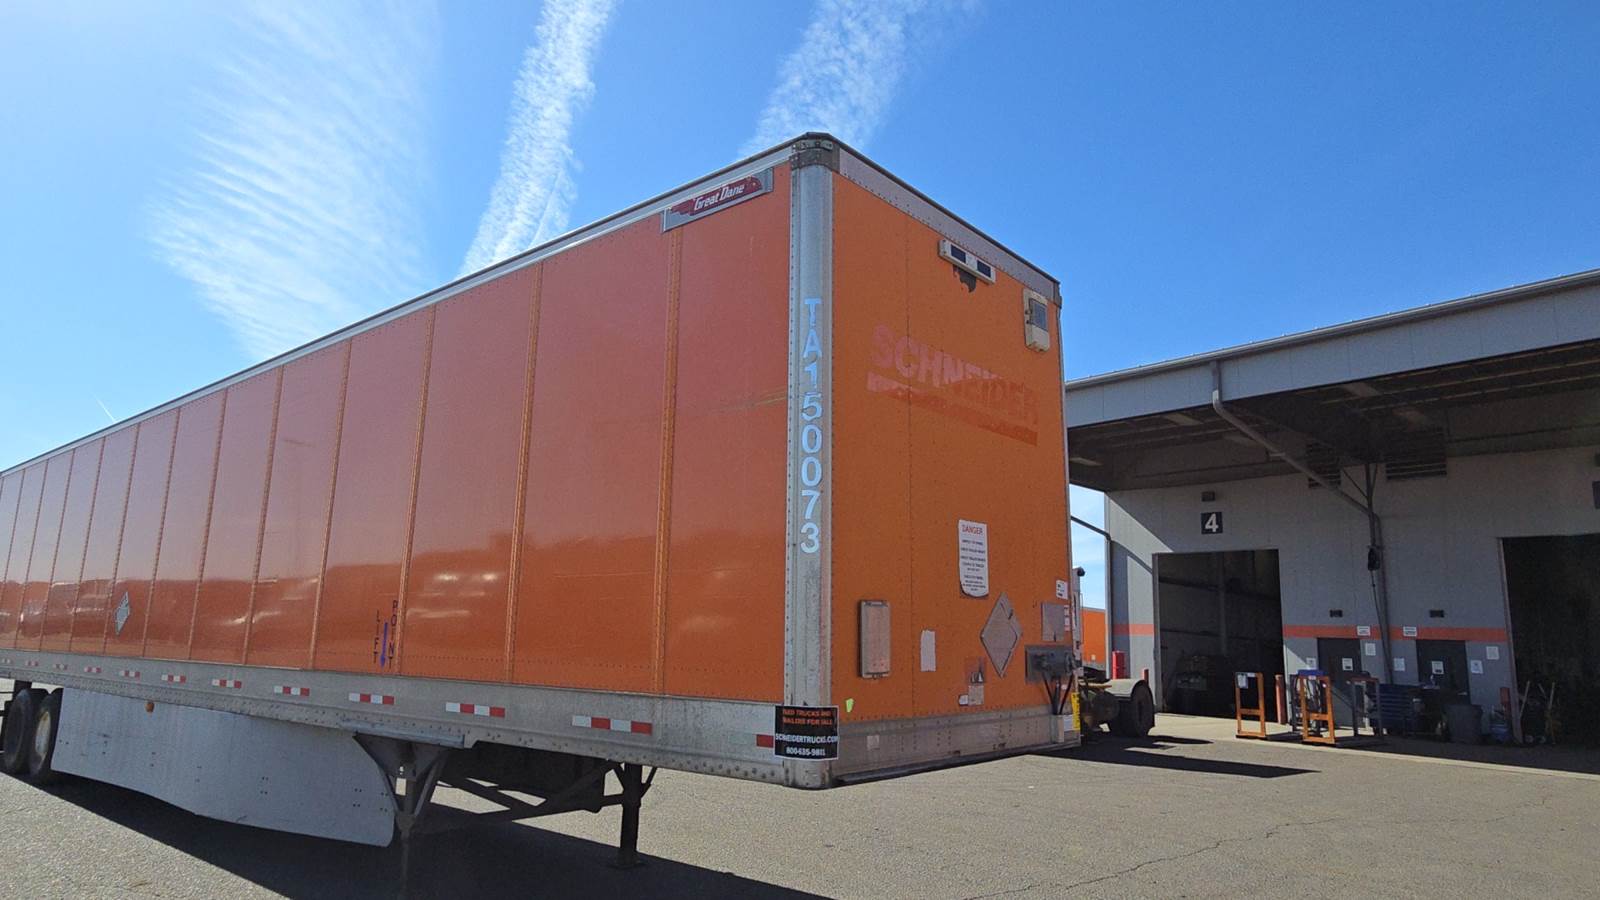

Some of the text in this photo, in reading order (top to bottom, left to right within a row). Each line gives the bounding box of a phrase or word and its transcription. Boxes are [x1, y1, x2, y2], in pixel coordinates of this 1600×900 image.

[693, 183, 746, 211] Great Dane
[801, 298, 822, 554] TA150073
[962, 524, 983, 535] DANGER
[1204, 512, 1219, 533] 4
